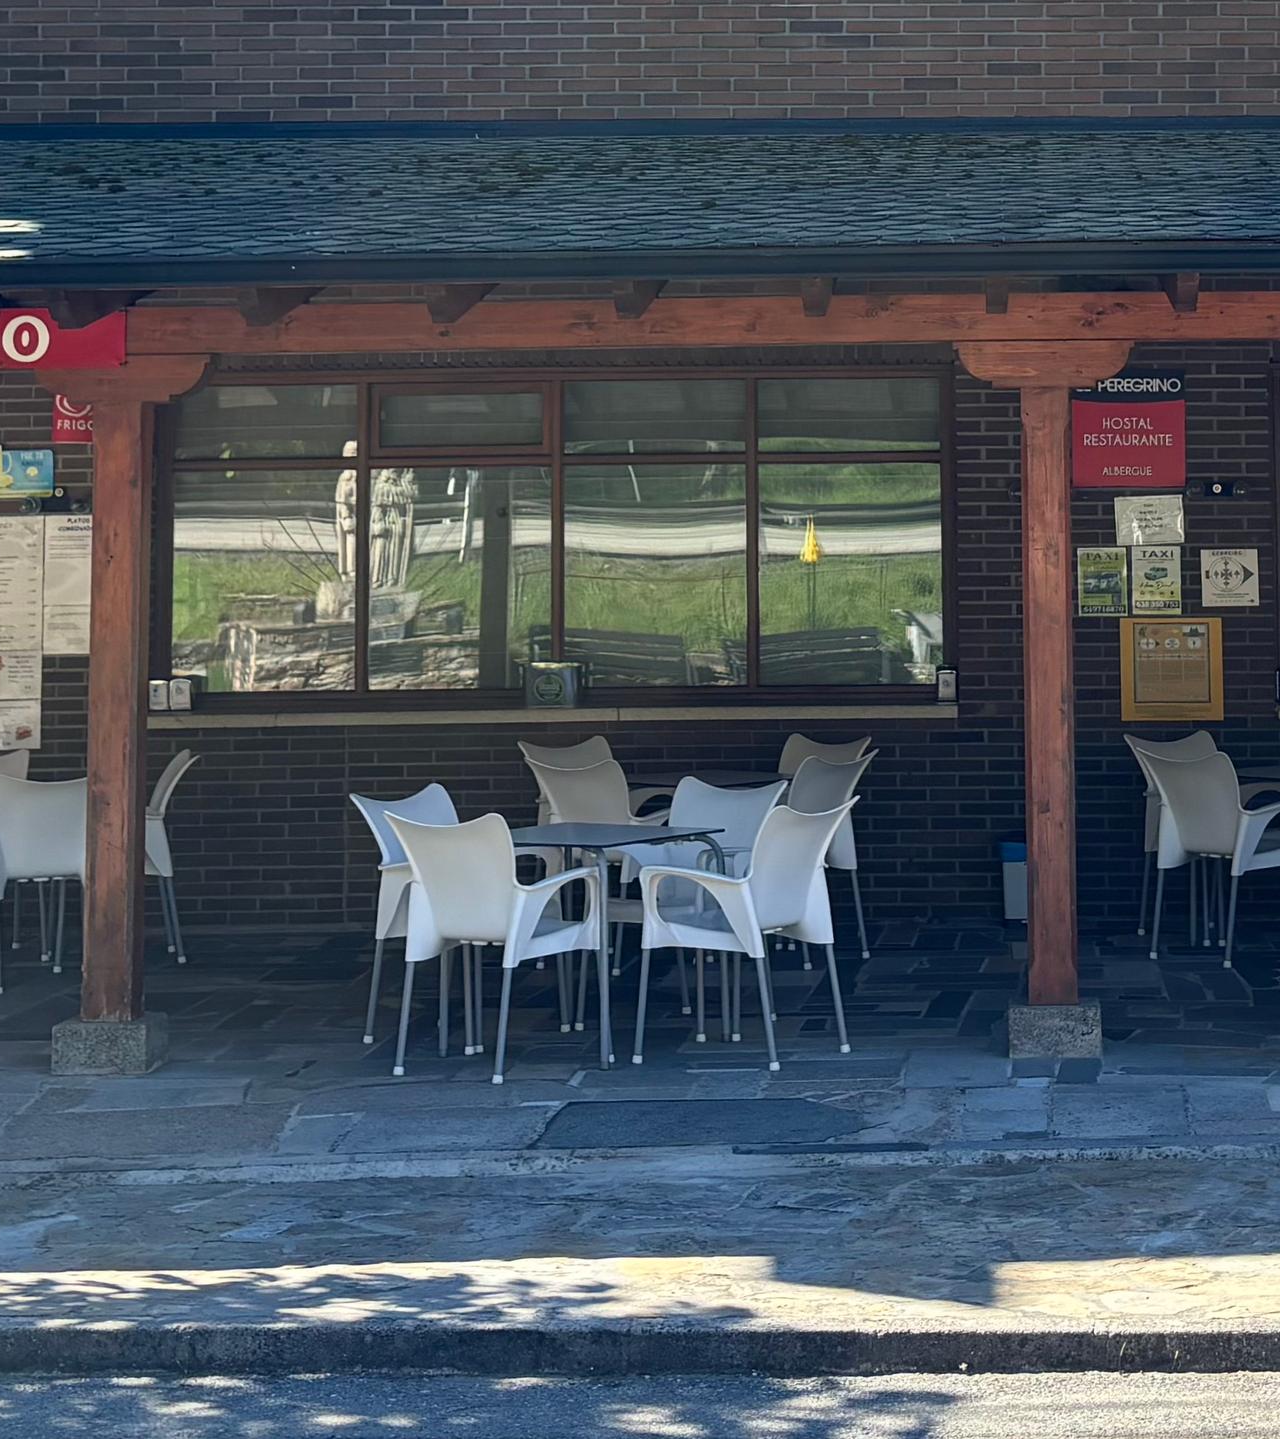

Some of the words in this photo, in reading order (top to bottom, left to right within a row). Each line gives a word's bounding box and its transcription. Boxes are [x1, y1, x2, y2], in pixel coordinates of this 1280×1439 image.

[1098, 378, 1181, 393] PEREGRINO
[1102, 417, 1154, 430] HOSTAL
[1083, 434, 1173, 446] RESTAURANTE
[1102, 466, 1152, 476] ALBERGUE
[1086, 552, 1120, 561] TAXI
[1140, 550, 1174, 558] TAXI
